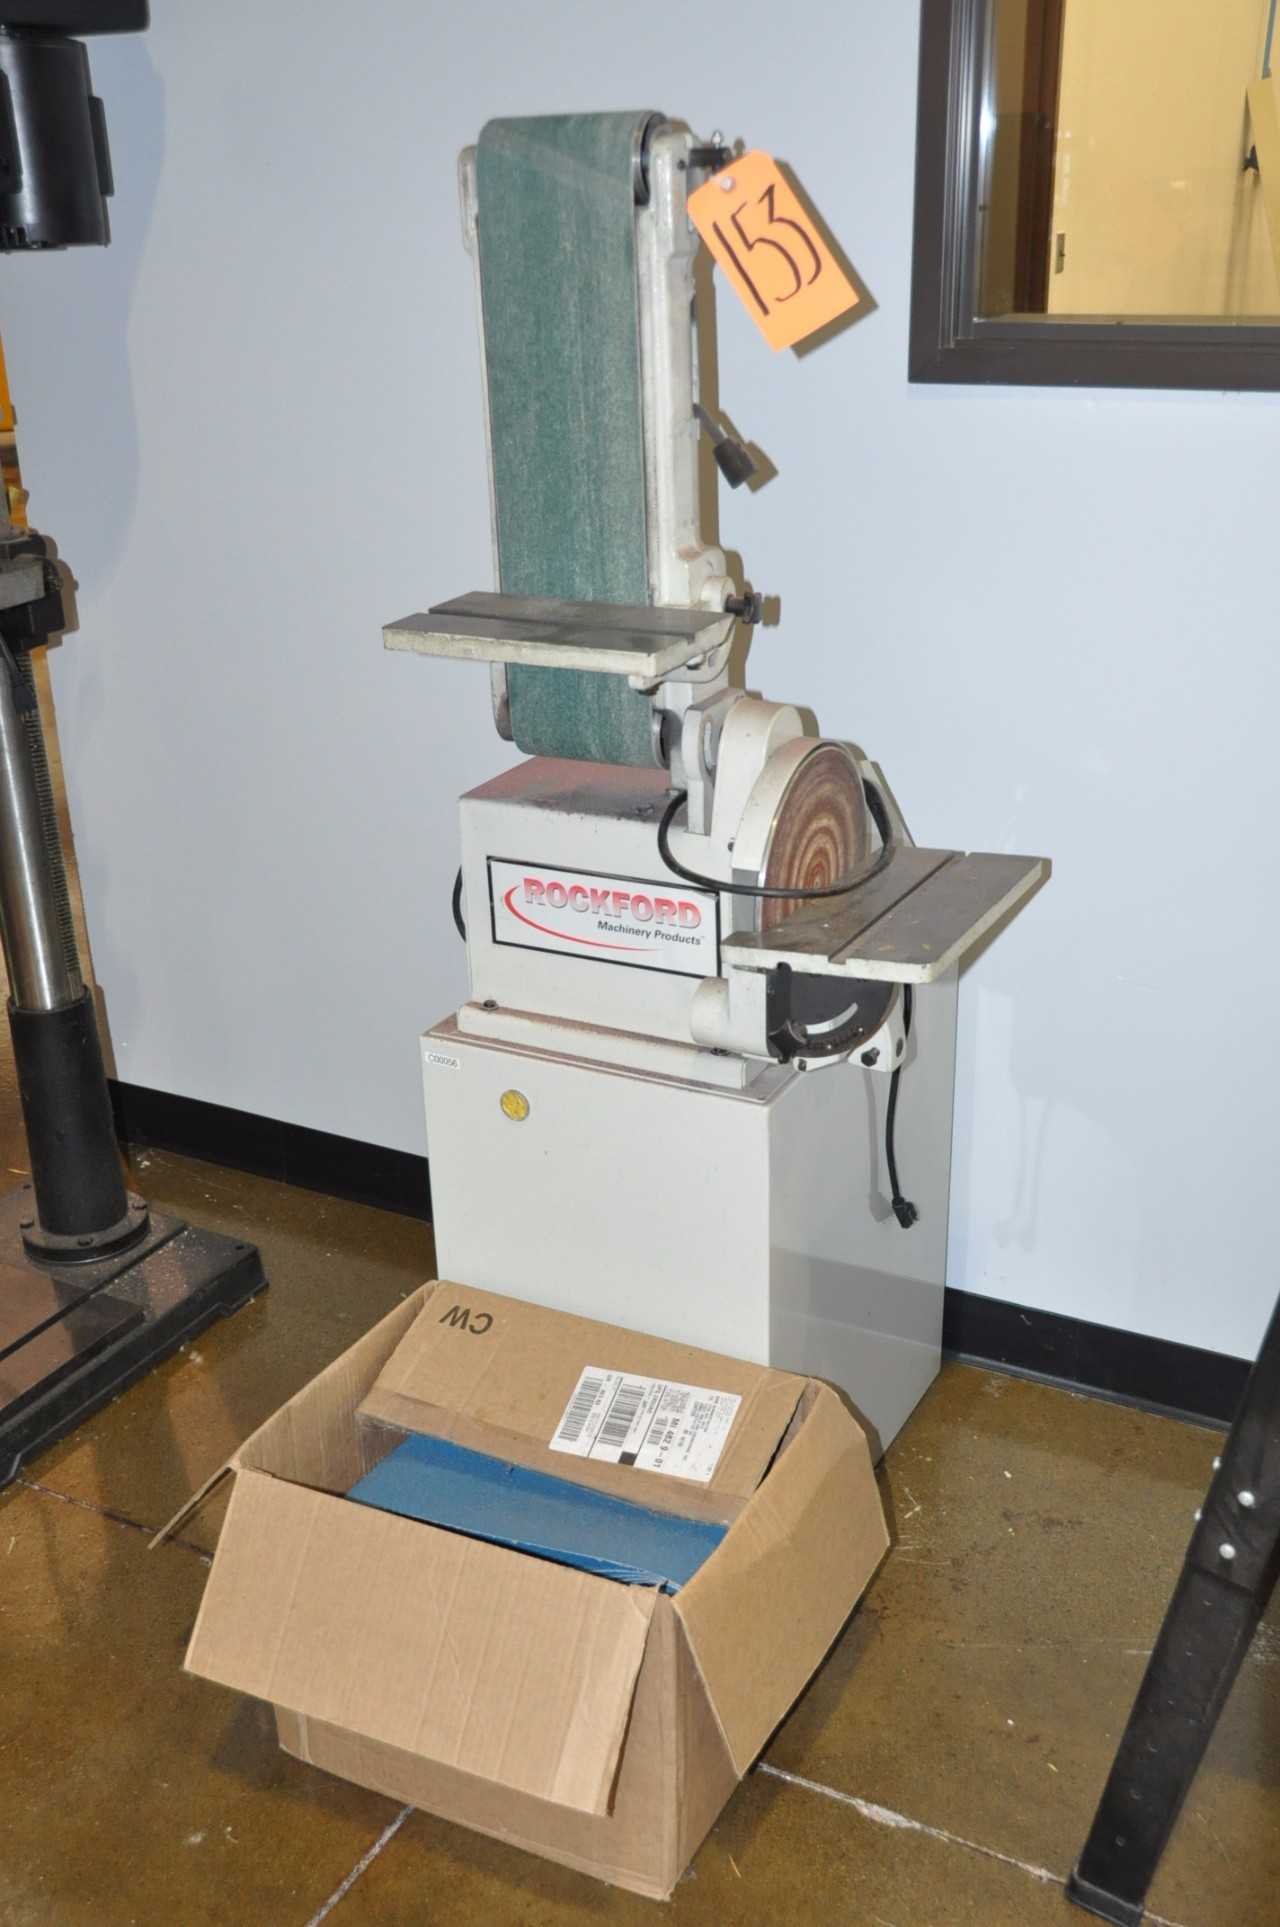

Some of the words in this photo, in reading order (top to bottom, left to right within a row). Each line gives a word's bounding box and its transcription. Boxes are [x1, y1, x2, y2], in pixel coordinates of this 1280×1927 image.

[712, 184, 822, 317] 153
[523, 877, 702, 929] ROCKFORD
[597, 919, 651, 940] Machinery
[654, 929, 701, 945] Products
[439, 1305, 494, 1334] CW
